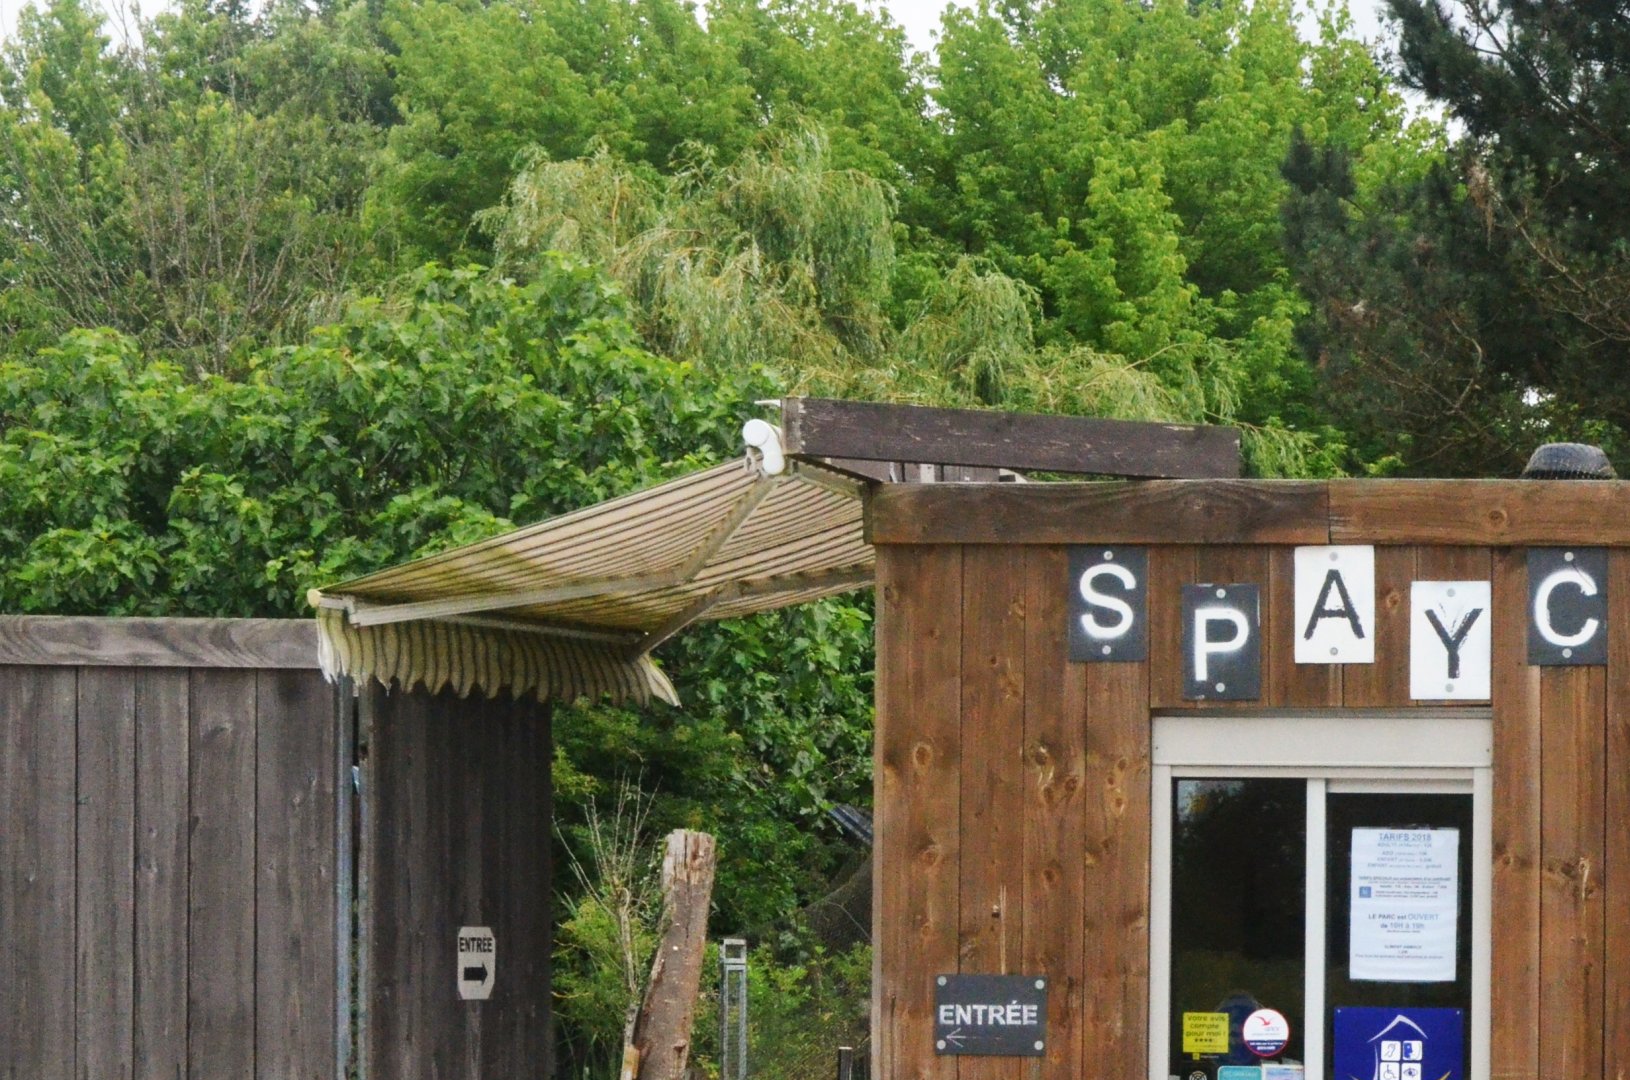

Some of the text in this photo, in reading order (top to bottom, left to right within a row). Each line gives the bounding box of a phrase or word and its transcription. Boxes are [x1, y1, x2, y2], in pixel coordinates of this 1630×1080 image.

[1379, 833, 1432, 841] TARIFS 2018
[459, 935, 493, 953] ENTRÉE
[939, 999, 1038, 1026] ENTRÉE
[1210, 1014, 1226, 1022] avis
